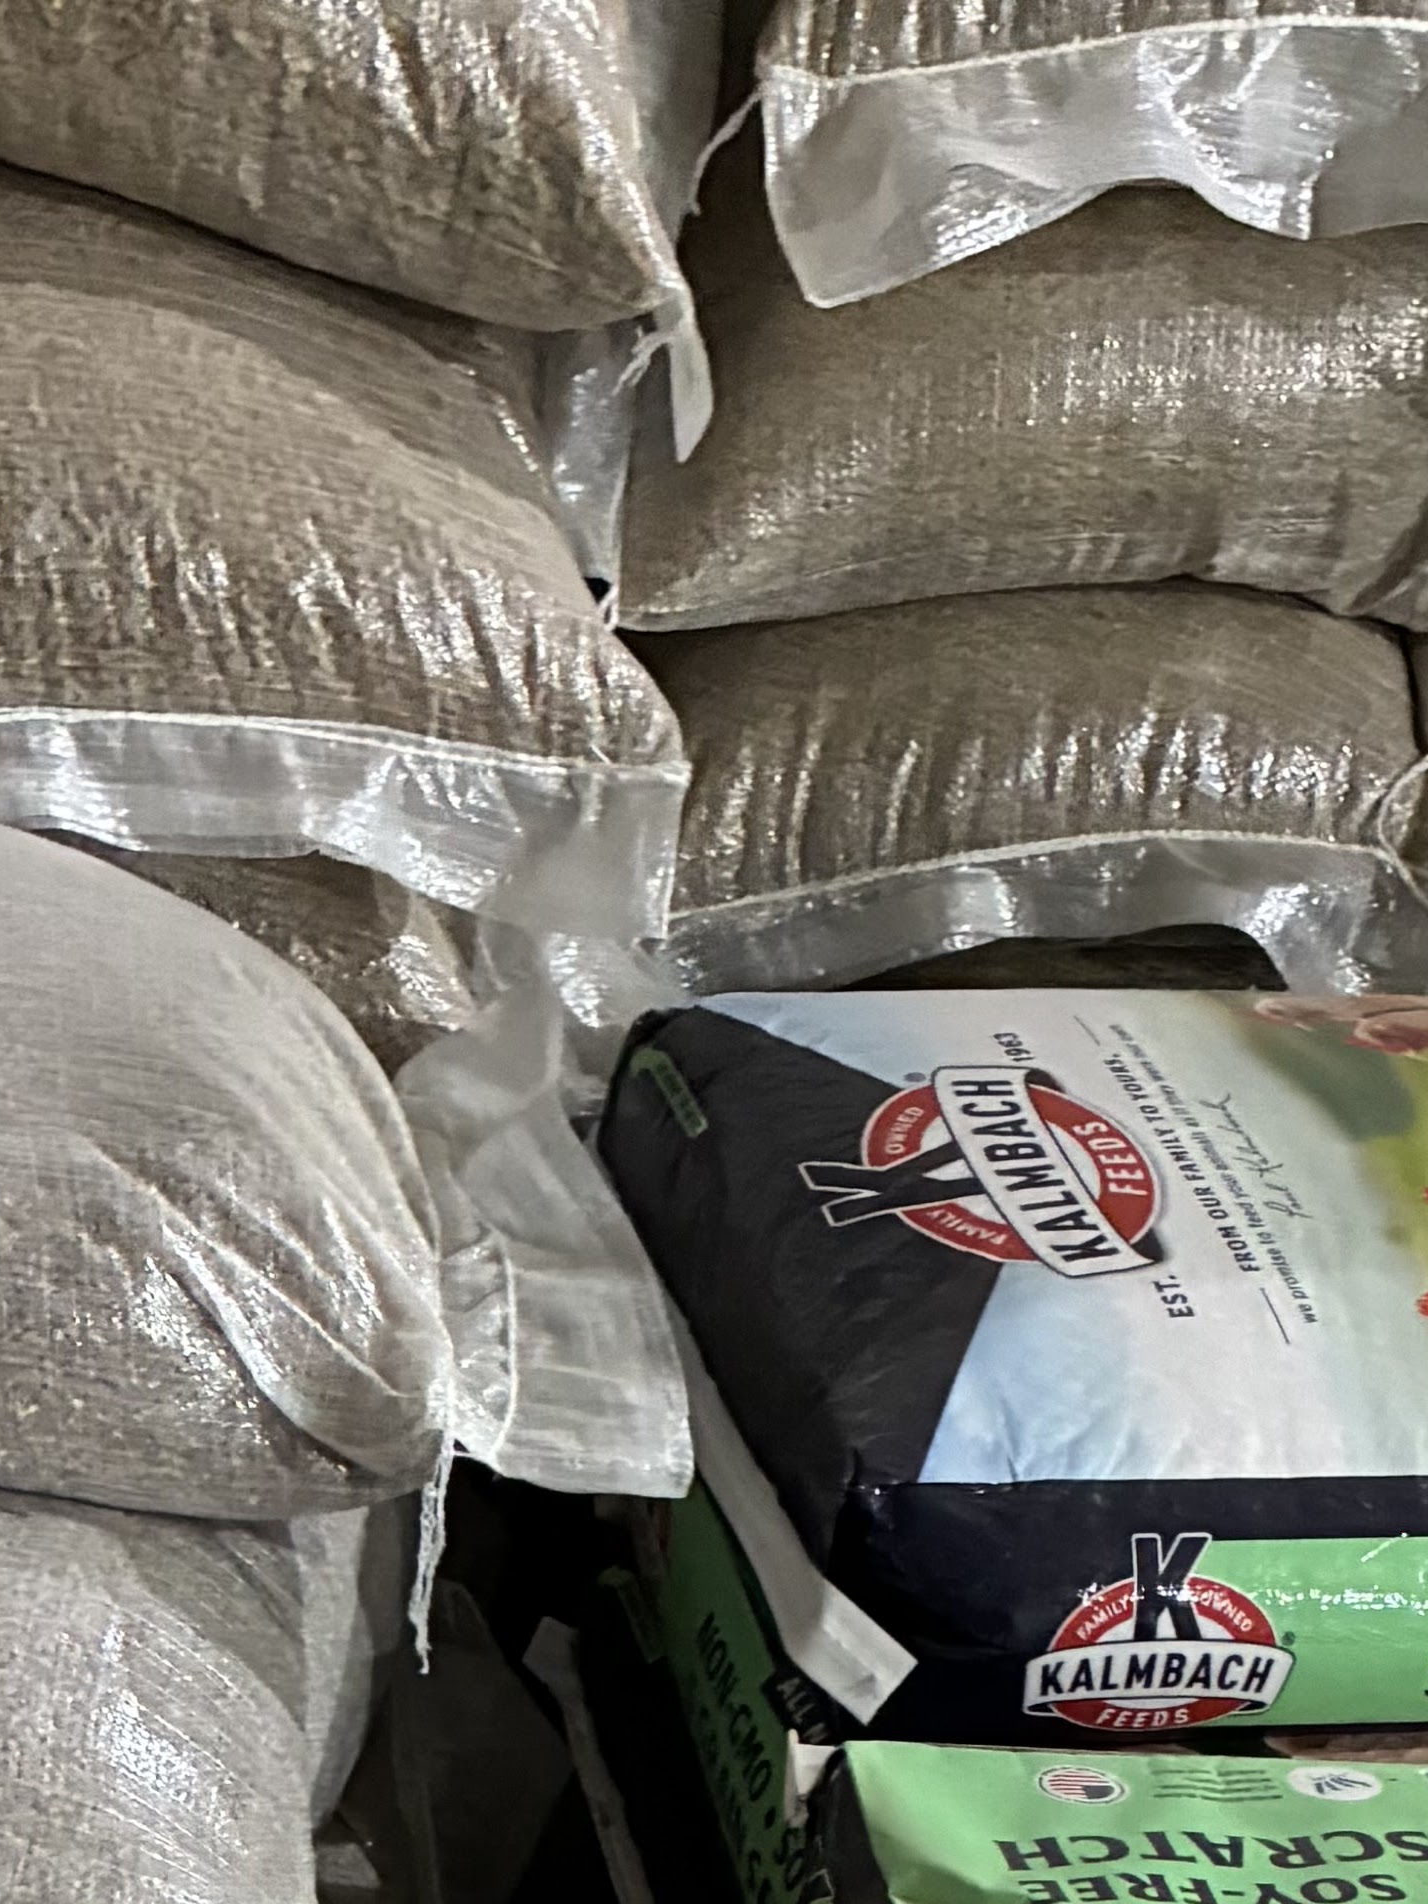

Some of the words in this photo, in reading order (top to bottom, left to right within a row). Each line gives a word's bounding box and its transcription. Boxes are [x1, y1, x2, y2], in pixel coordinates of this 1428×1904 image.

[993, 1032, 1035, 1062] 1963
[884, 1105, 926, 1156] OWNED
[1139, 1103, 1164, 1124] TO
[951, 1079, 1122, 1263] KALMBACH
[1072, 1120, 1150, 1197] FEEDS
[1154, 1127, 1205, 1182] FAMILY
[1194, 1185, 1229, 1221] OUR
[927, 1207, 1008, 1247] FAMILY
[1217, 1225, 1260, 1273] FROM
[1152, 1275, 1195, 1318] EST.
[1076, 1599, 1129, 1641] FAMILY
[1039, 1651, 1275, 1697] KALMBACH
[696, 1612, 770, 1802] NON-GMO
[1095, 1707, 1190, 1728] FEEDS
